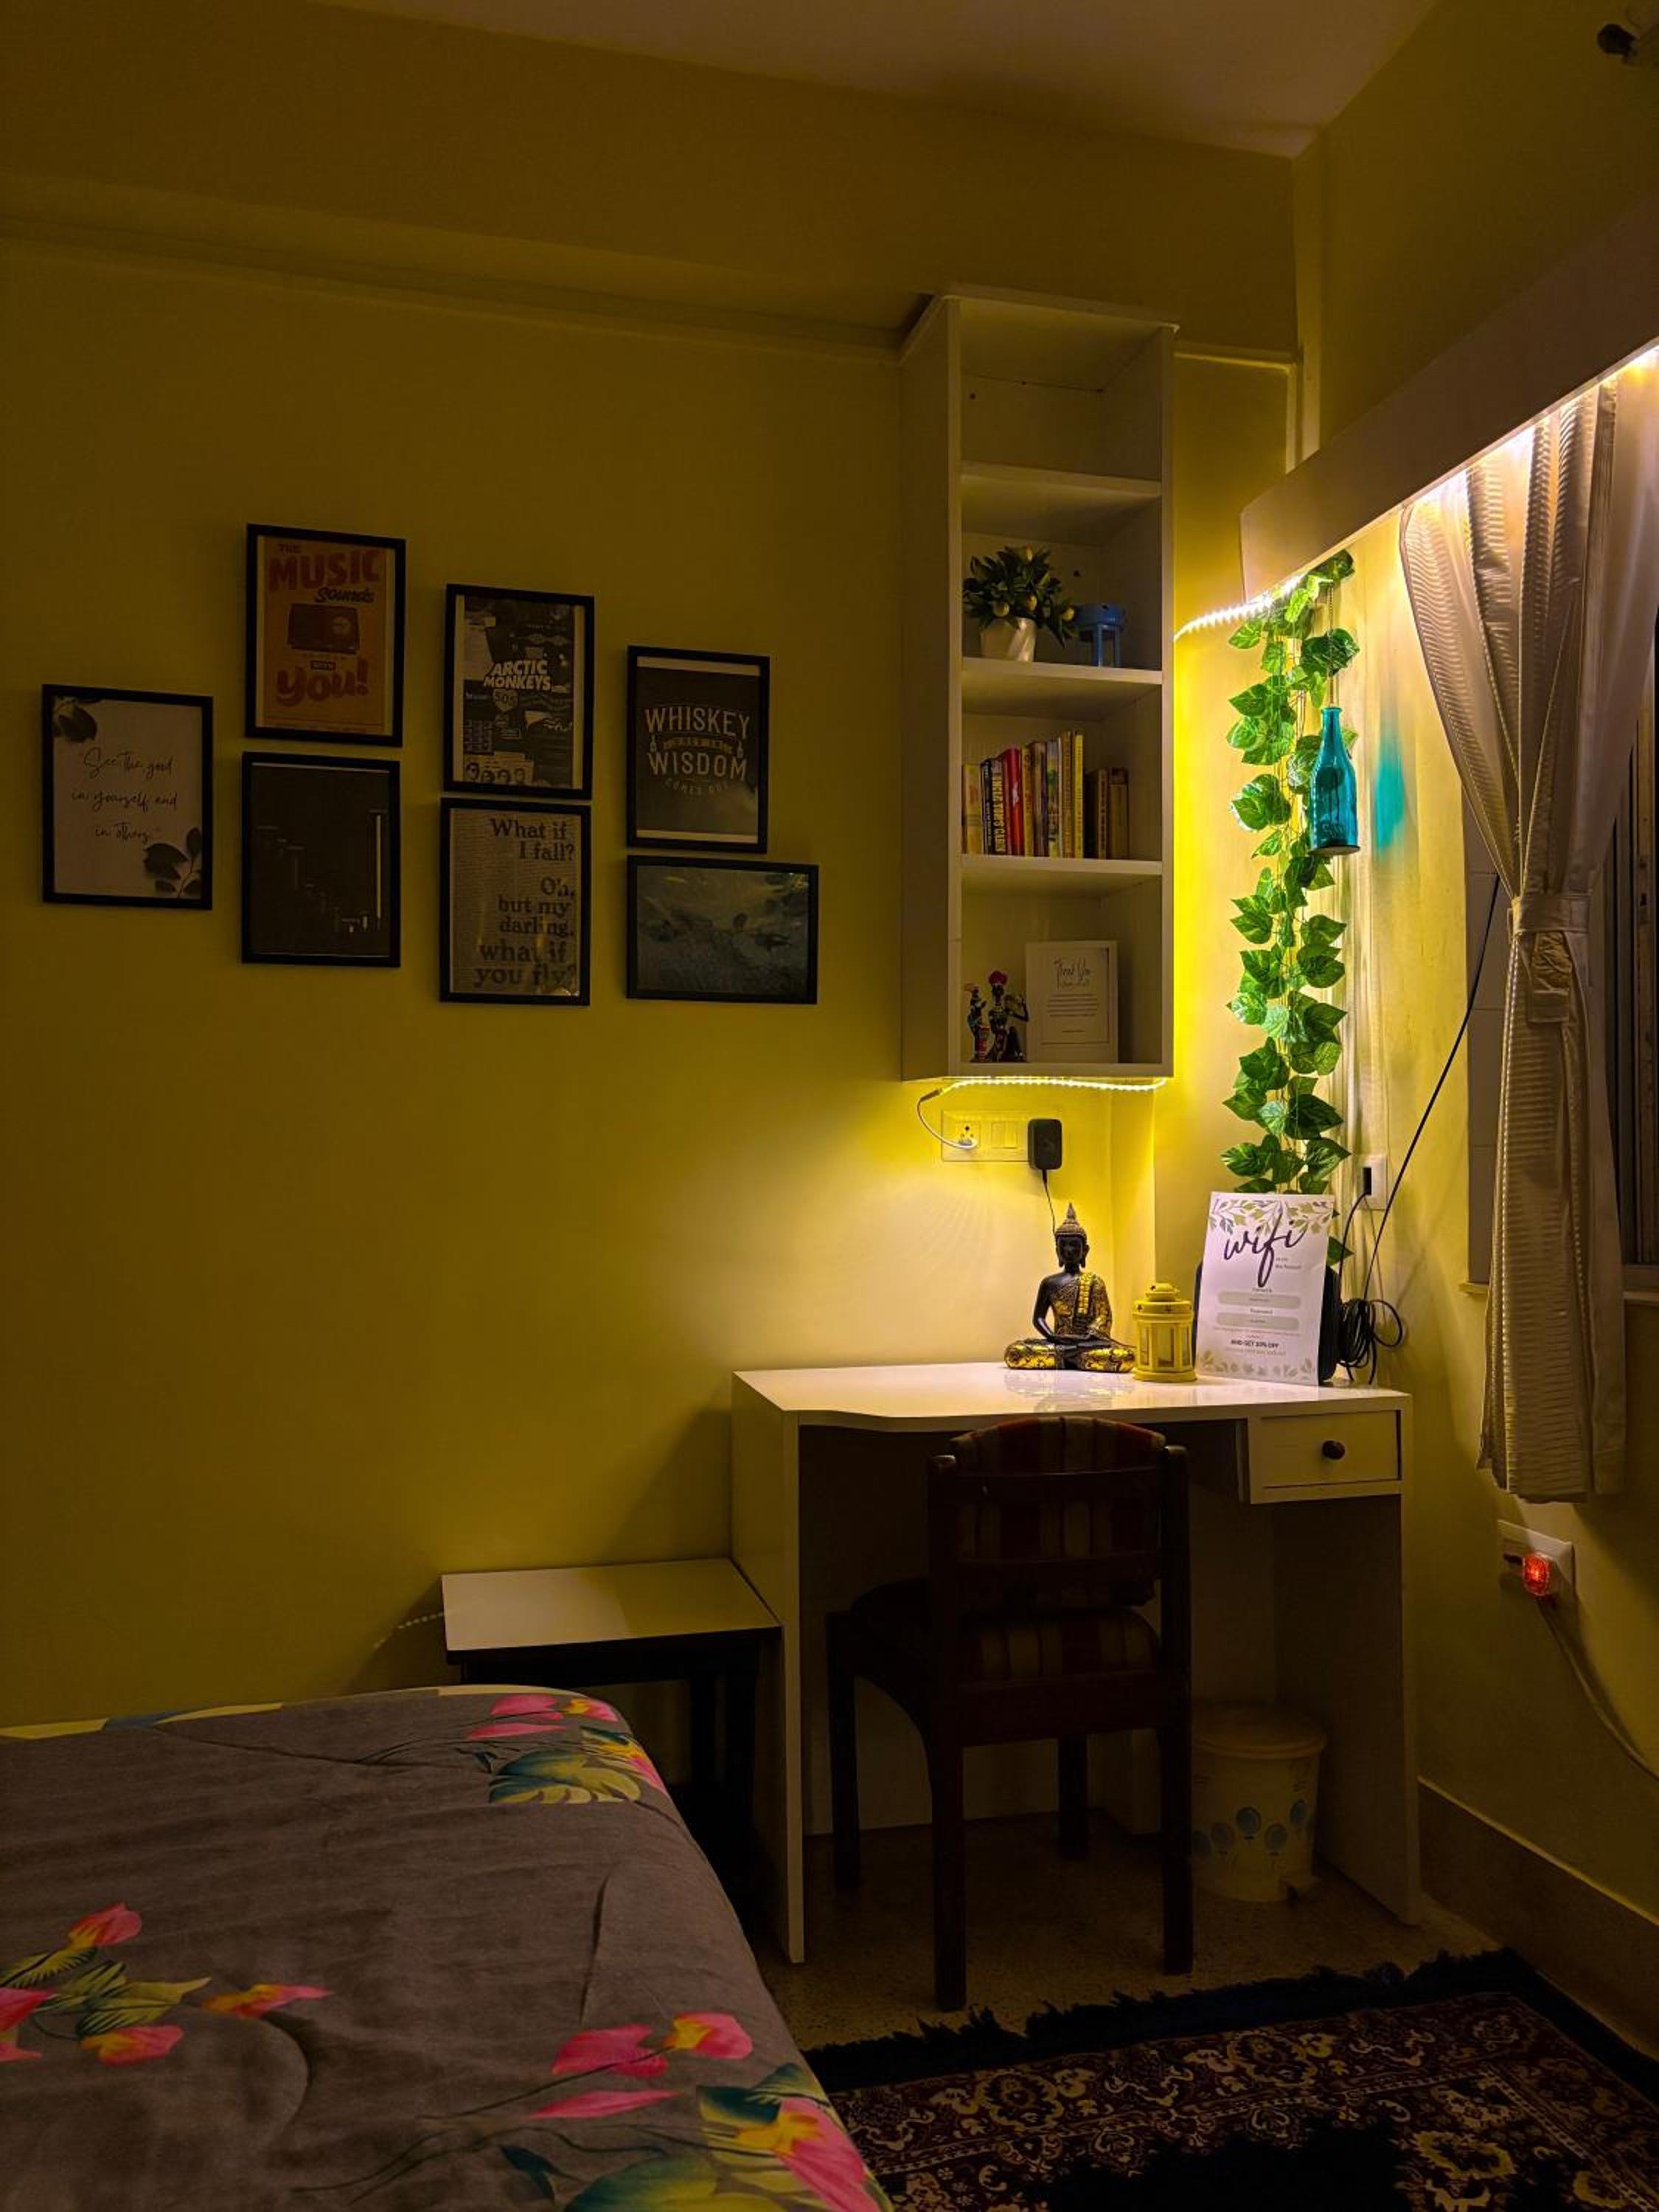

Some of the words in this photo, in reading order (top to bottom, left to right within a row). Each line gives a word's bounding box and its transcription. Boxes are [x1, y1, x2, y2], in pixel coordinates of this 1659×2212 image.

[277, 543, 301, 554] THE
[270, 550, 382, 590] MUSIC
[490, 660, 548, 676] ARCTIC
[276, 658, 369, 706] you!
[483, 675, 552, 691] MONKEYS
[644, 706, 750, 740] WHISKEY
[647, 751, 748, 781] WISDOM
[93, 790, 148, 813] yourself
[155, 792, 178, 810] and
[491, 818, 544, 838] What
[554, 821, 567, 839] if
[519, 841, 526, 859] I
[534, 842, 575, 861] fall?
[498, 894, 531, 913] but
[539, 901, 571, 918] my
[479, 939, 542, 962] what
[549, 942, 567, 962] if
[474, 967, 521, 988] you
[532, 964, 577, 987] fly?
[1223, 1214, 1307, 1287] wifi
